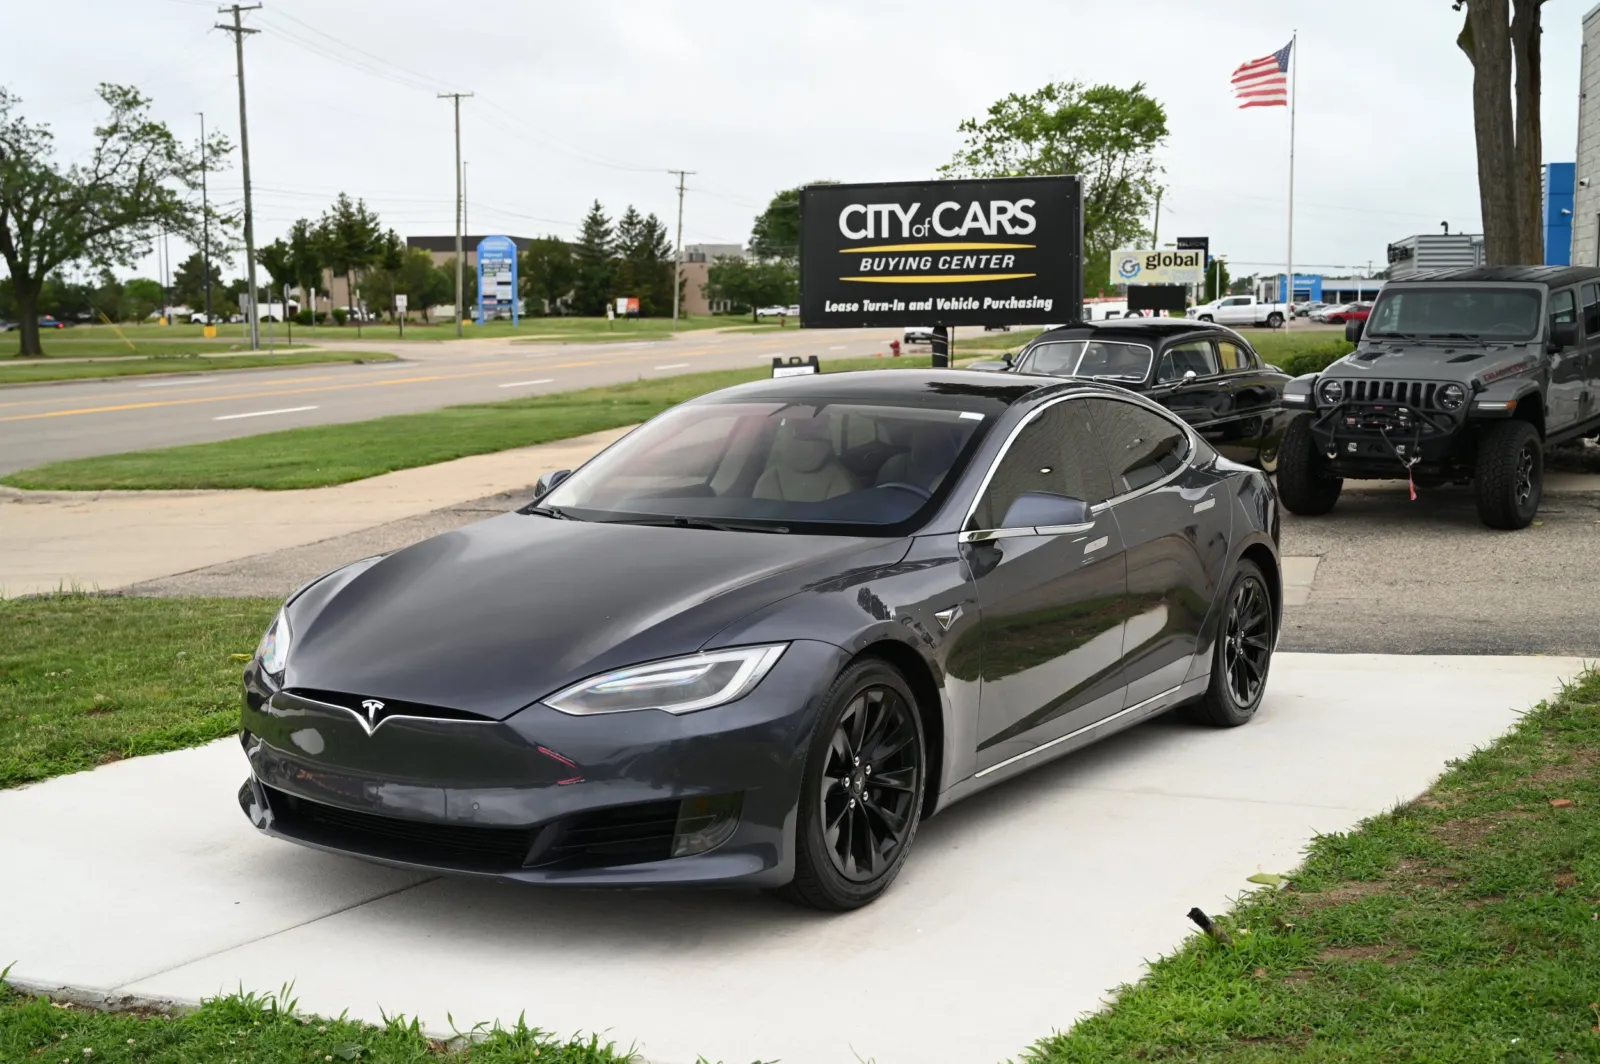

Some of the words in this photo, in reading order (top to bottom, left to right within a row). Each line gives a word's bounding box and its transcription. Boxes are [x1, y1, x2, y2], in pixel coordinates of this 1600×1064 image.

[838, 202, 921, 240] CITY
[912, 217, 932, 238] of
[931, 198, 1037, 237] CARS
[859, 257, 933, 272] BUYING
[937, 254, 1016, 270] CENTER
[1145, 252, 1199, 270] global
[824, 300, 860, 313] Lease
[862, 299, 906, 312] Turn-In
[908, 297, 933, 311] and
[936, 297, 980, 311] Vehicle
[982, 295, 1054, 312] Purchasing
